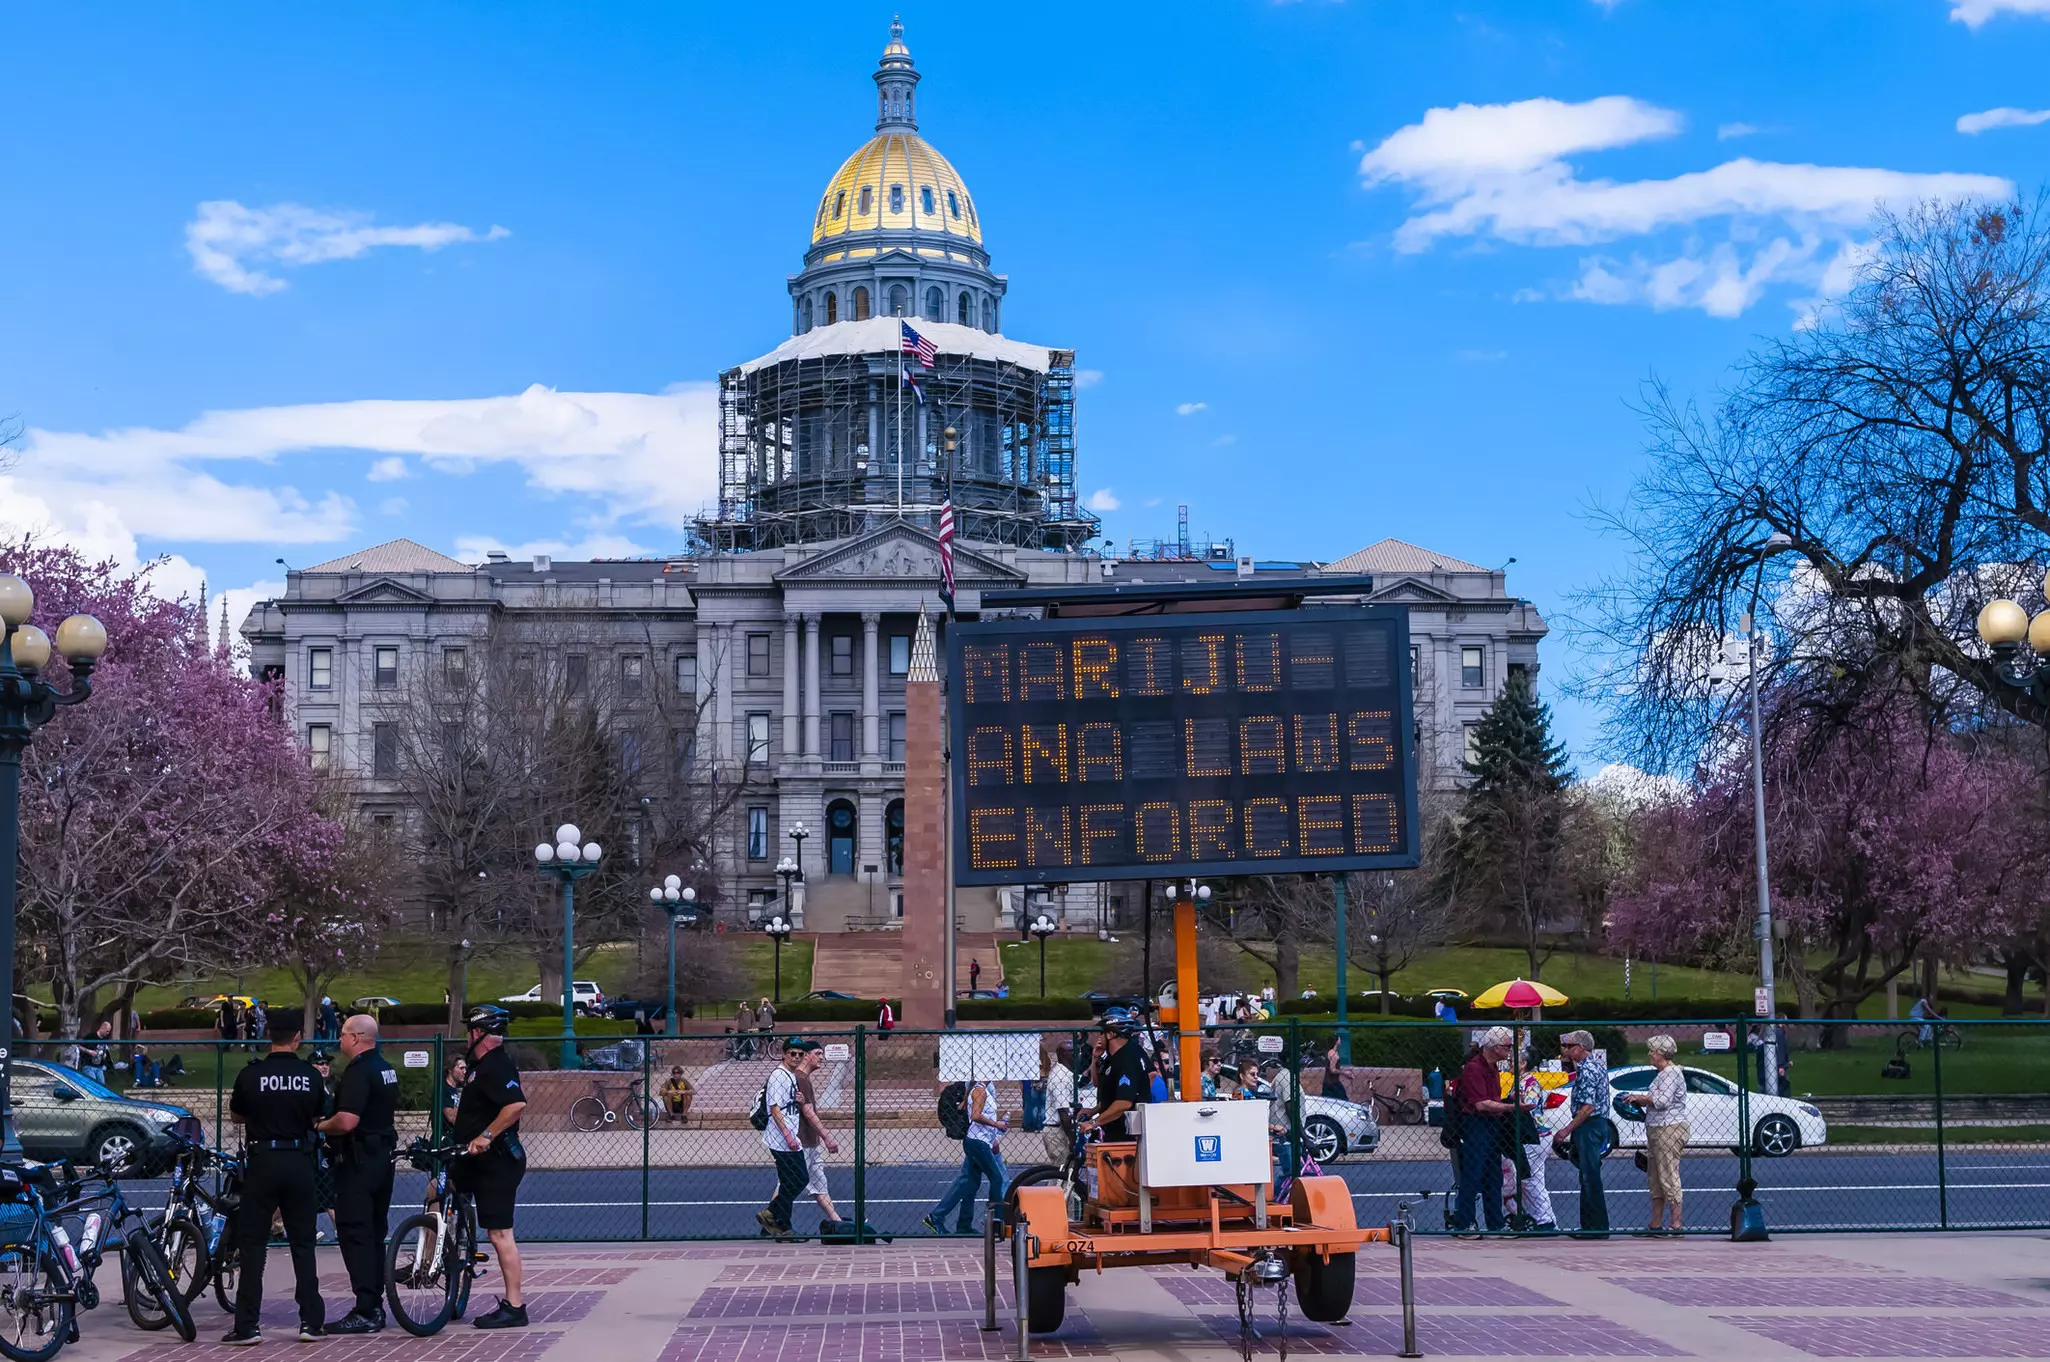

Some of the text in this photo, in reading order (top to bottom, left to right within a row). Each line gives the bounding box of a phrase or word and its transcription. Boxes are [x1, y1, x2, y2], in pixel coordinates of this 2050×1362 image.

[964, 633, 1334, 704] MARIJU-
[968, 710, 1395, 787] ANA LAWS
[970, 793, 1399, 869] ENFORCED
[260, 1075, 311, 1092] POLICE
[1067, 1240, 1095, 1252] QZ4
